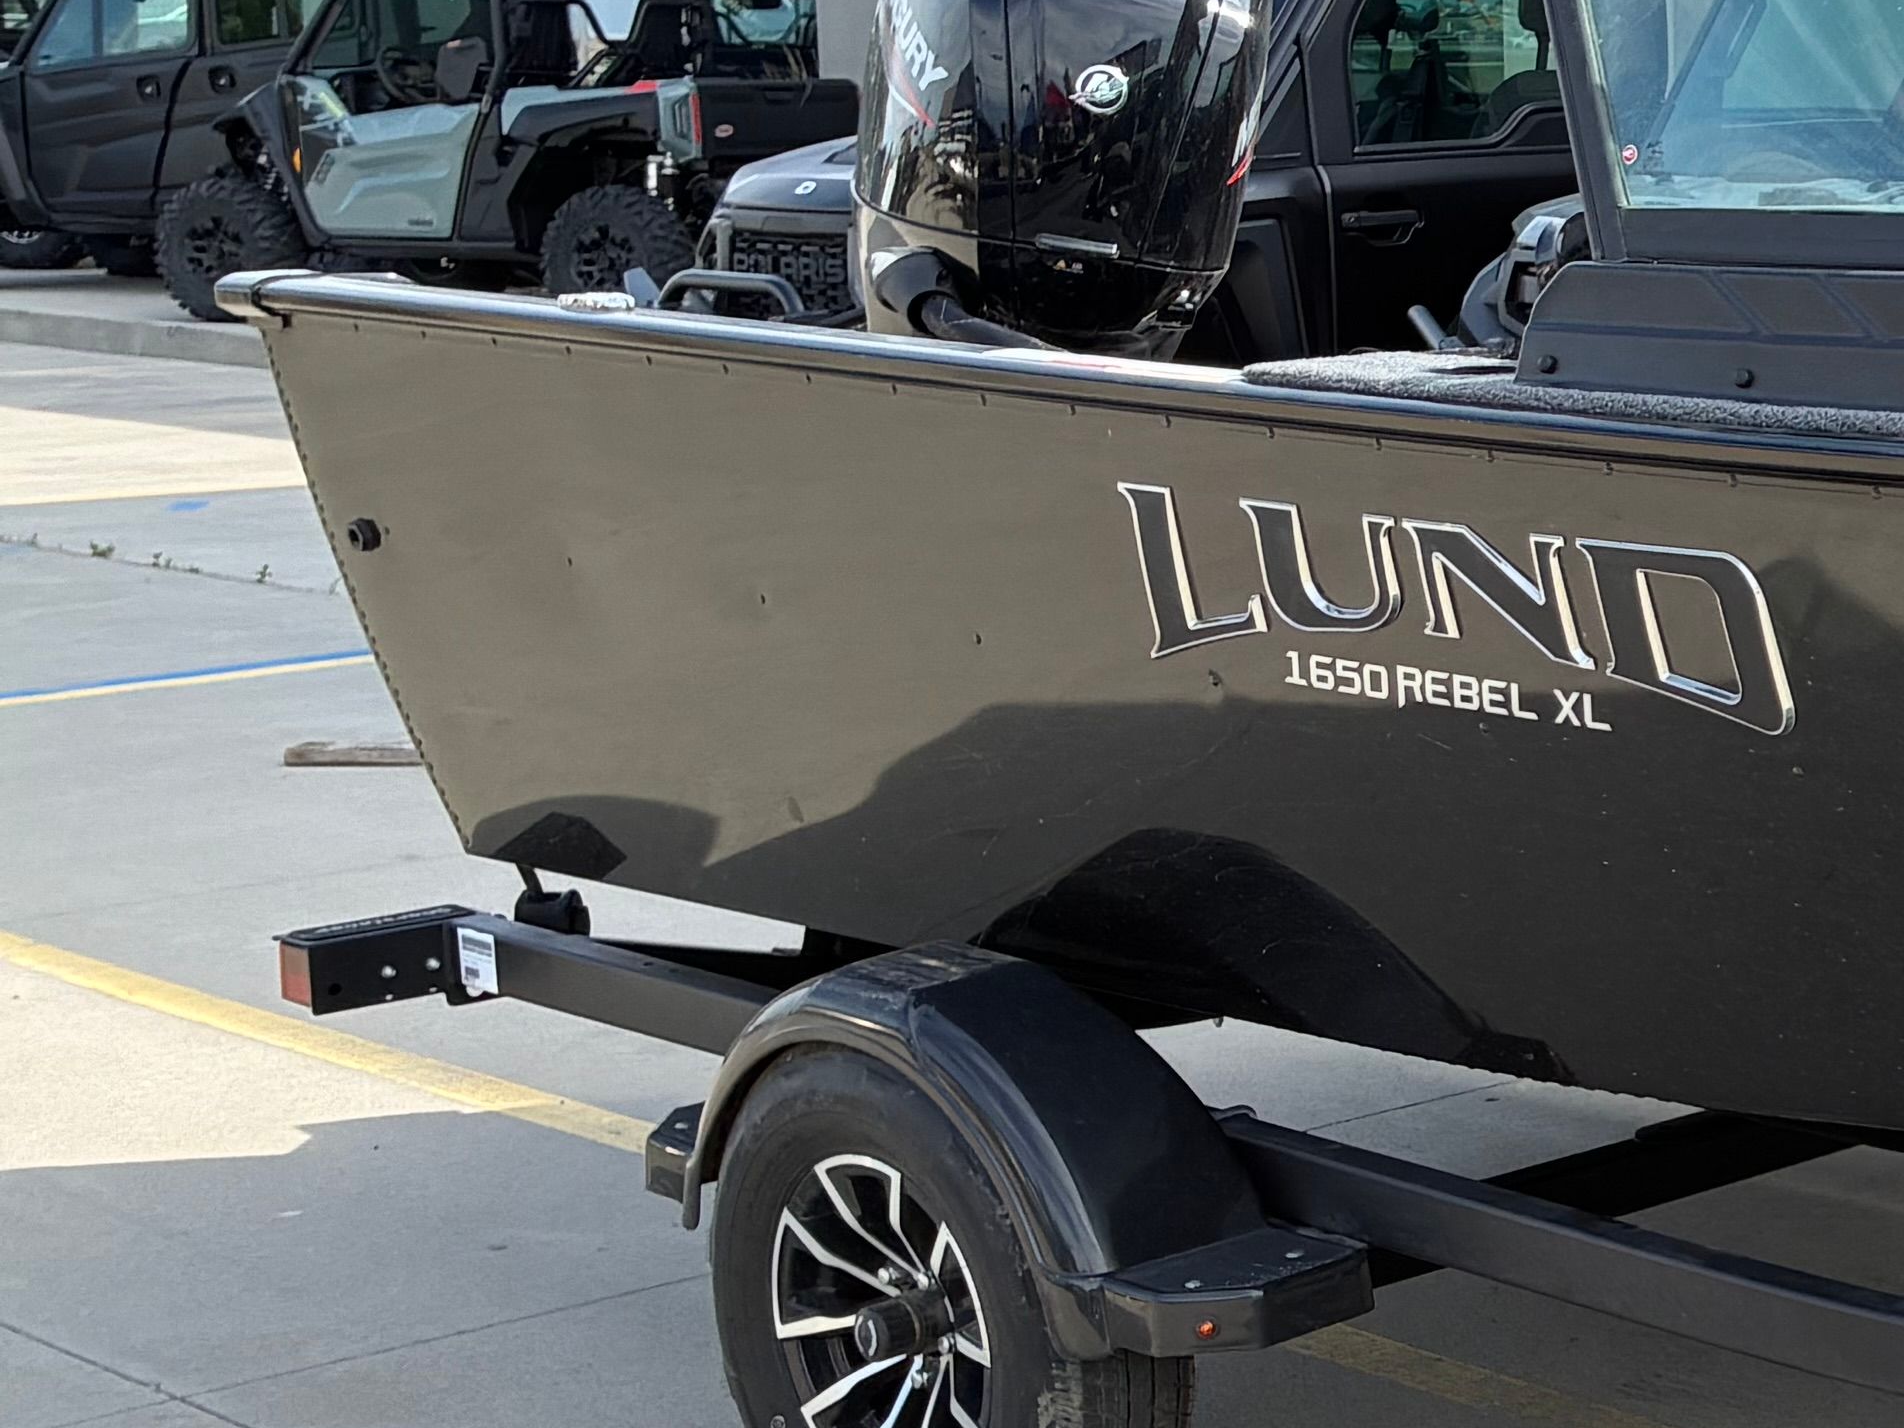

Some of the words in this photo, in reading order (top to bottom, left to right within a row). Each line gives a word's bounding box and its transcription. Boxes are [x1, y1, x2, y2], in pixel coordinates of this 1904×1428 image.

[1116, 481, 1797, 737] LUND
[1284, 650, 1389, 700] 1650
[1397, 665, 1539, 722] REBEL
[1553, 687, 1613, 733] XL
